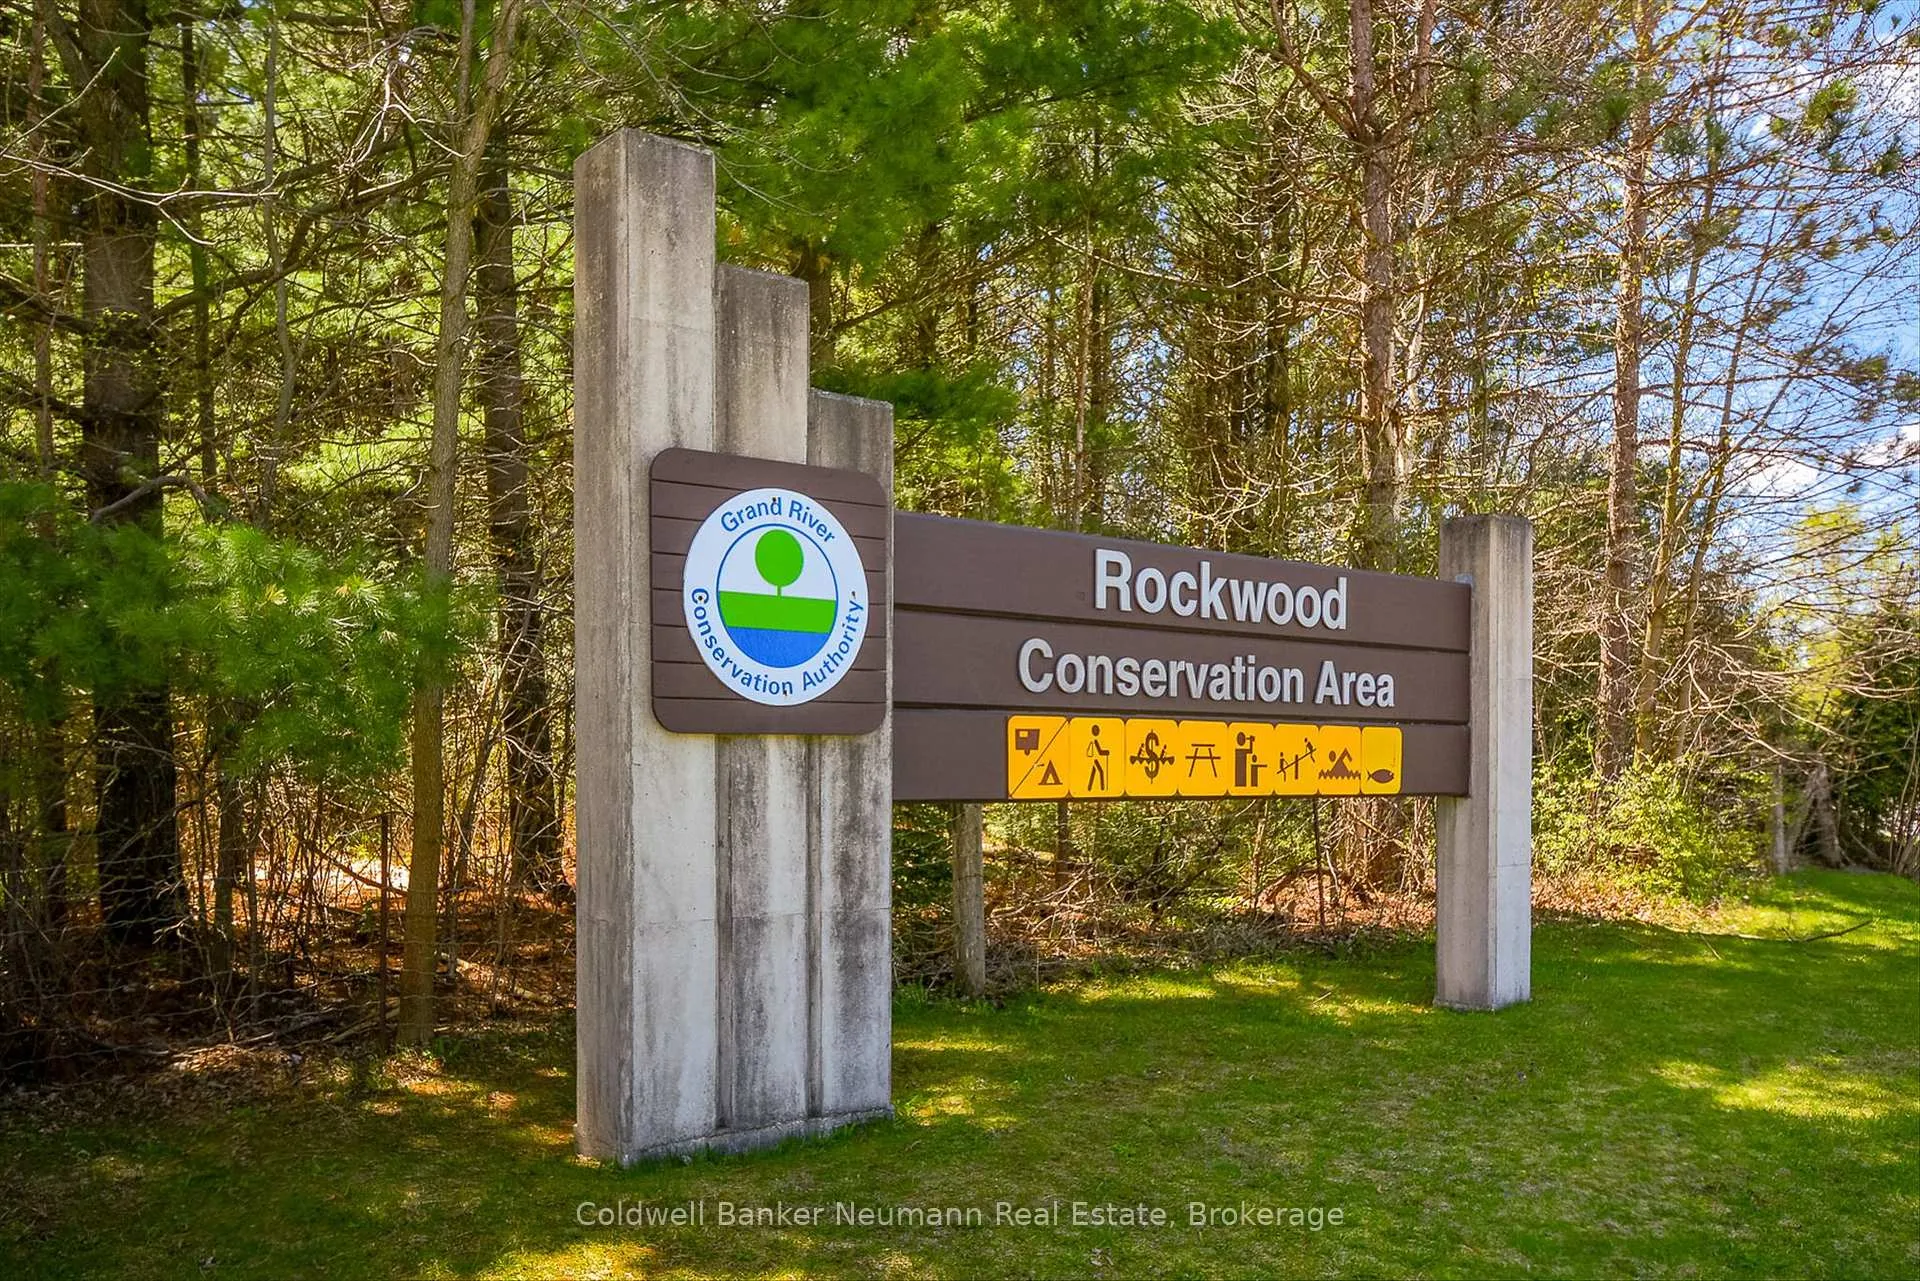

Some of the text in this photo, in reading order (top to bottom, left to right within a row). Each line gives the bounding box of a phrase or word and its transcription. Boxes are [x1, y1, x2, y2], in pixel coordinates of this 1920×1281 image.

[720, 496, 836, 544] Grand River
[1094, 548, 1348, 631] Rockwood
[691, 587, 864, 696] Conservation Authority
[1018, 637, 1395, 708] Conservation Area
